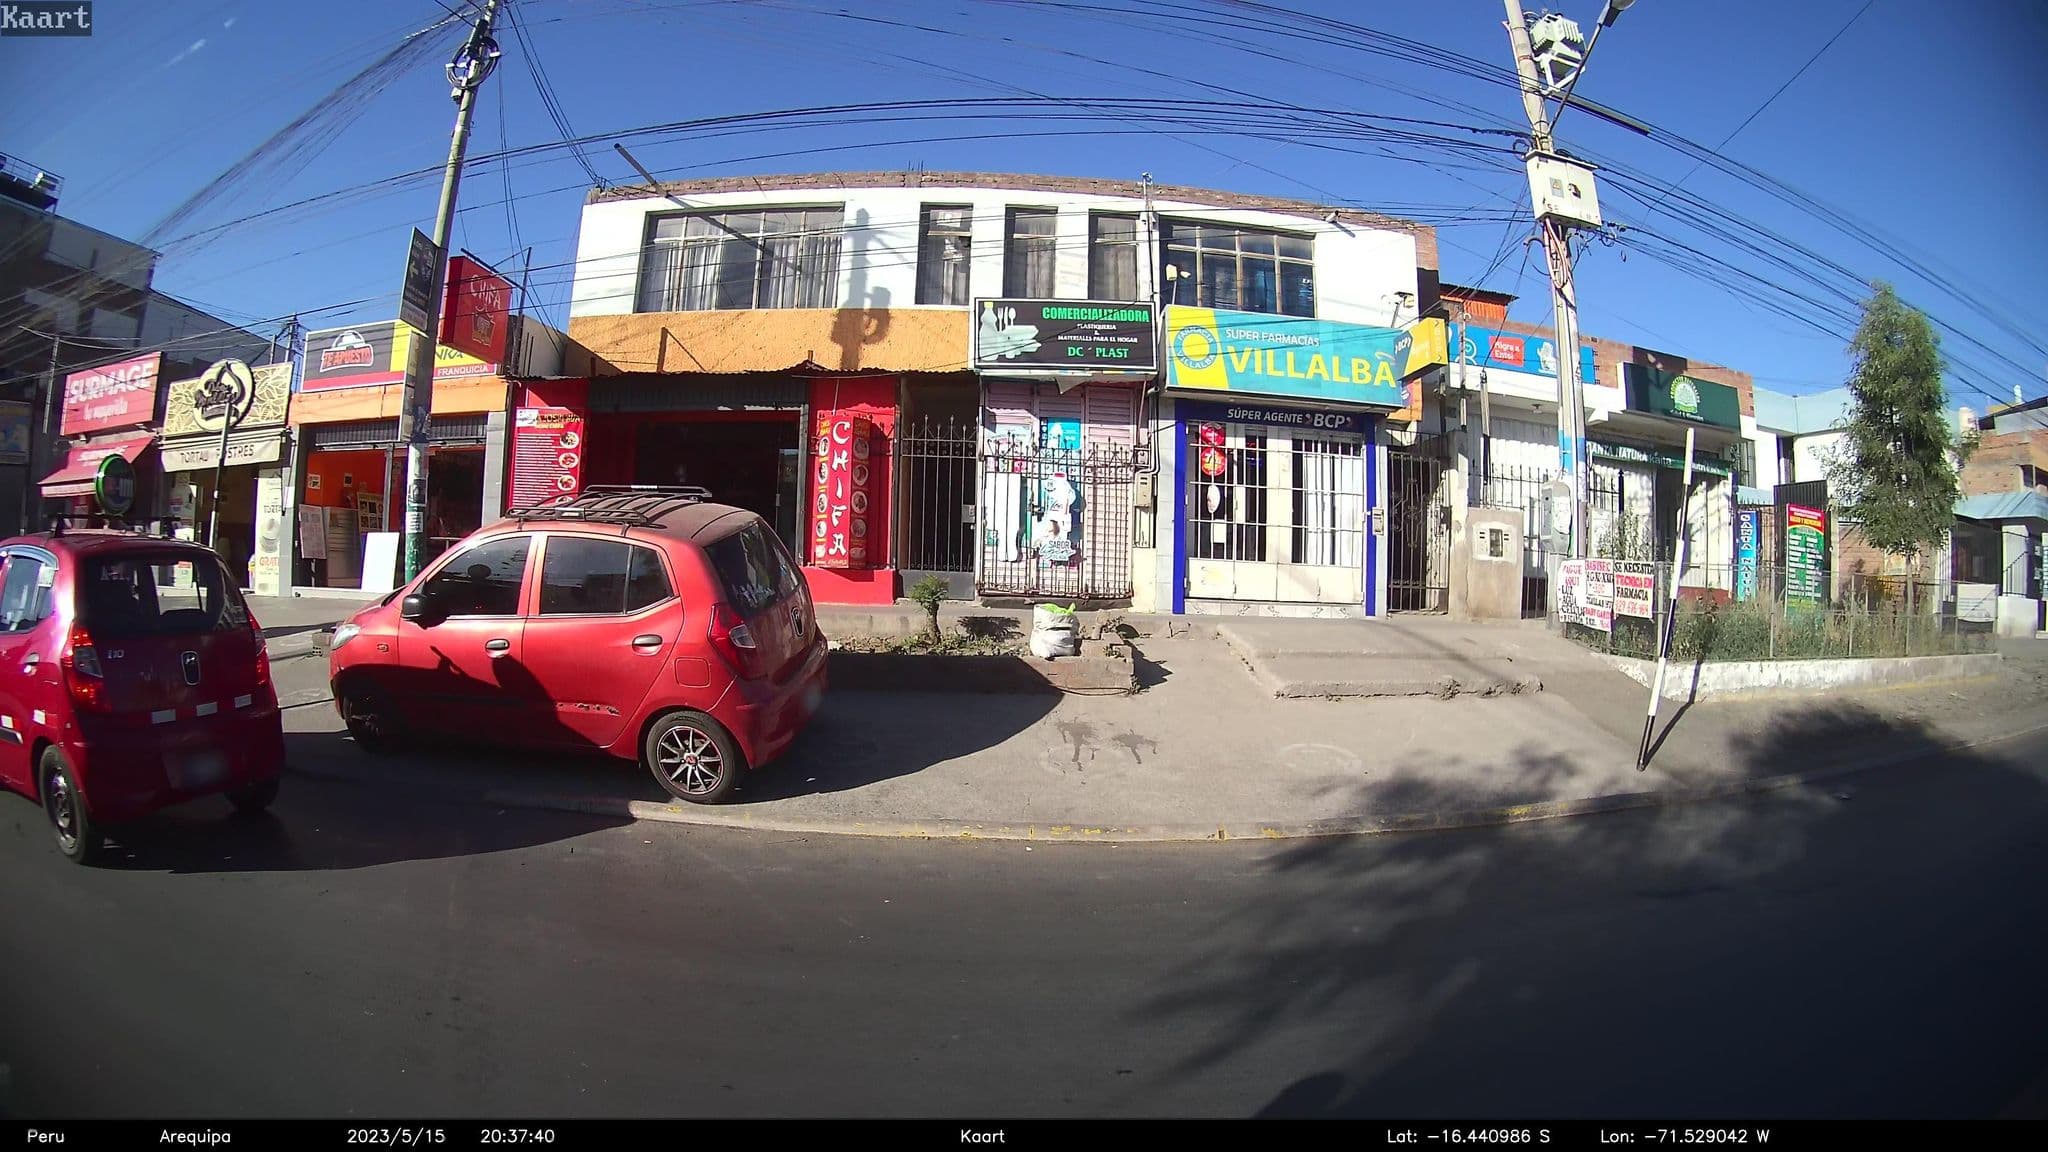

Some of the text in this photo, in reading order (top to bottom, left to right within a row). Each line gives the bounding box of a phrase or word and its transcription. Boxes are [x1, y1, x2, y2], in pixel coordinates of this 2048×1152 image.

[1042, 306, 1150, 323] COMERCIALIZADORA
[1225, 328, 1321, 347] SUPER FARMACIAS
[1067, 346, 1129, 359] DC PLAST
[438, 363, 489, 377] FRANQUICIA
[1227, 345, 1397, 388] VILLALBA
[1227, 407, 1345, 429] SÚPER AGENTE BCP
[215, 445, 255, 461] PSTRES
[828, 420, 851, 556] CHIFA
[1740, 513, 1752, 551] SANTA
[1616, 587, 1649, 602] FARMACIA
